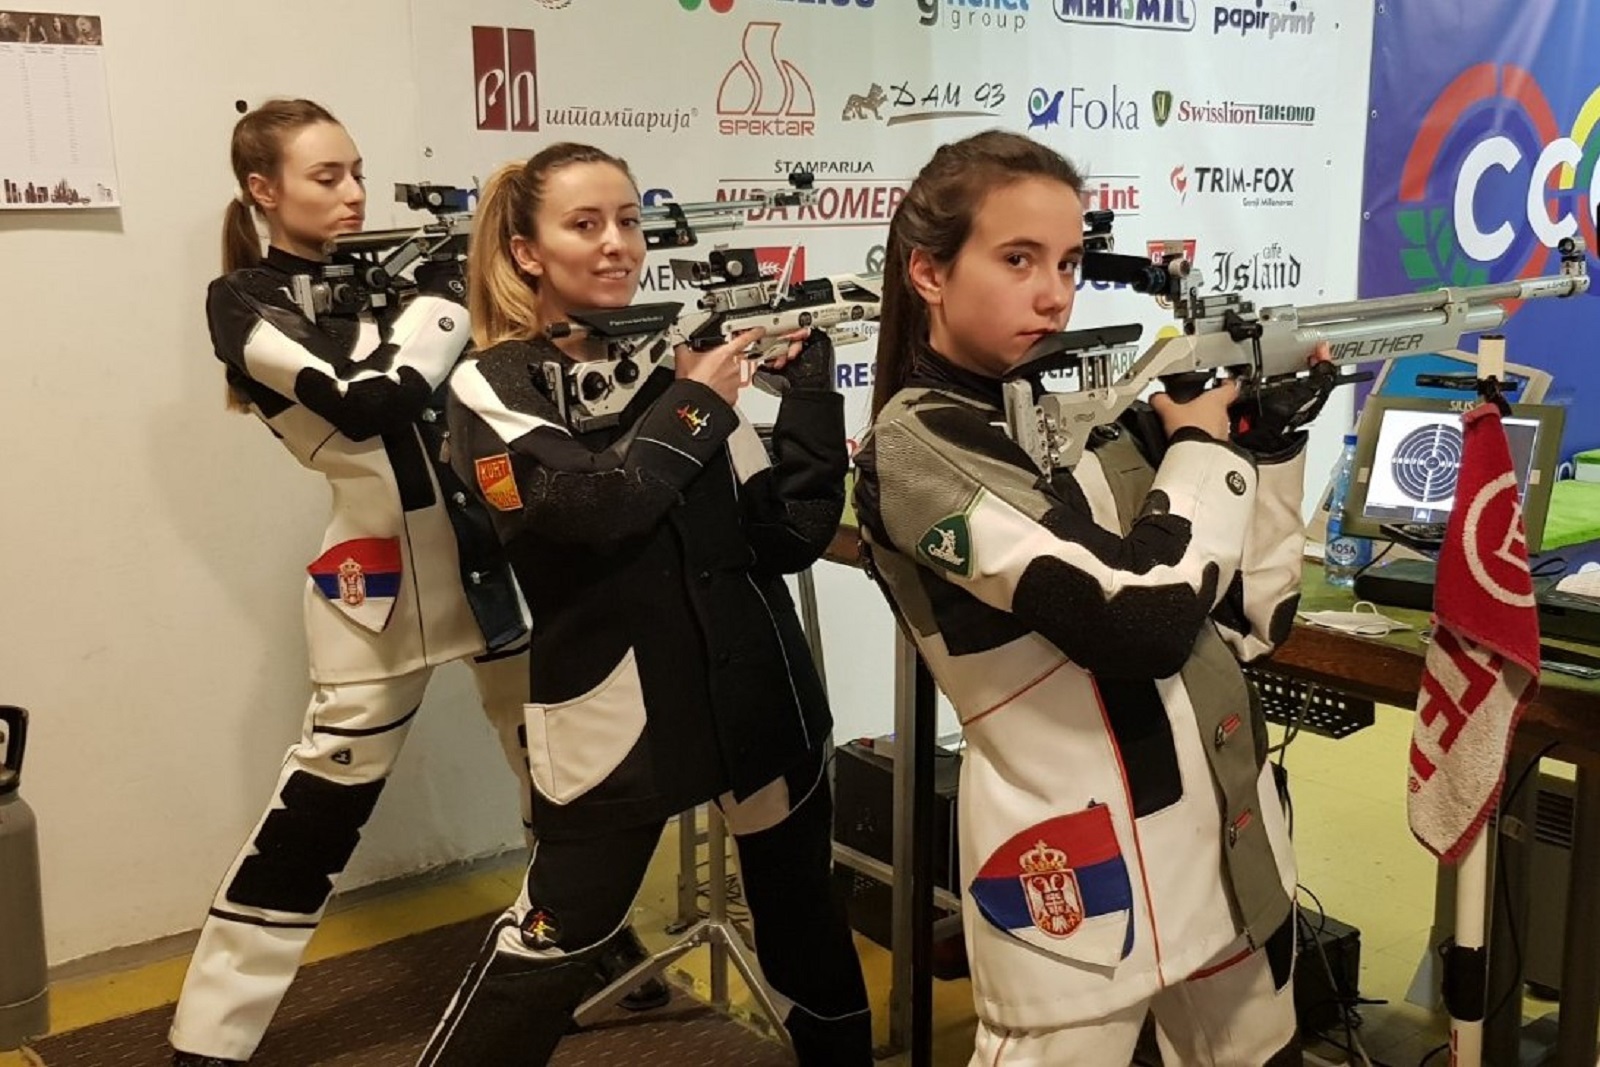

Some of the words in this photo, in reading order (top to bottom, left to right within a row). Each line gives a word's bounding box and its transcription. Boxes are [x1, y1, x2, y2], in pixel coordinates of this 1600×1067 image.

[951, 10, 1026, 33] group
[890, 80, 962, 108] DAM
[974, 82, 1006, 109] 93
[1070, 84, 1140, 130] Foka
[1177, 99, 1256, 124] Swisslion
[773, 159, 875, 174] ŠTAMPARIJA
[1194, 166, 1294, 193] TRIM-FOX
[1454, 136, 1600, 262] CC
[1210, 251, 1302, 292] Island
[1329, 333, 1424, 361] WALTHER
[479, 460, 507, 481] KURT
